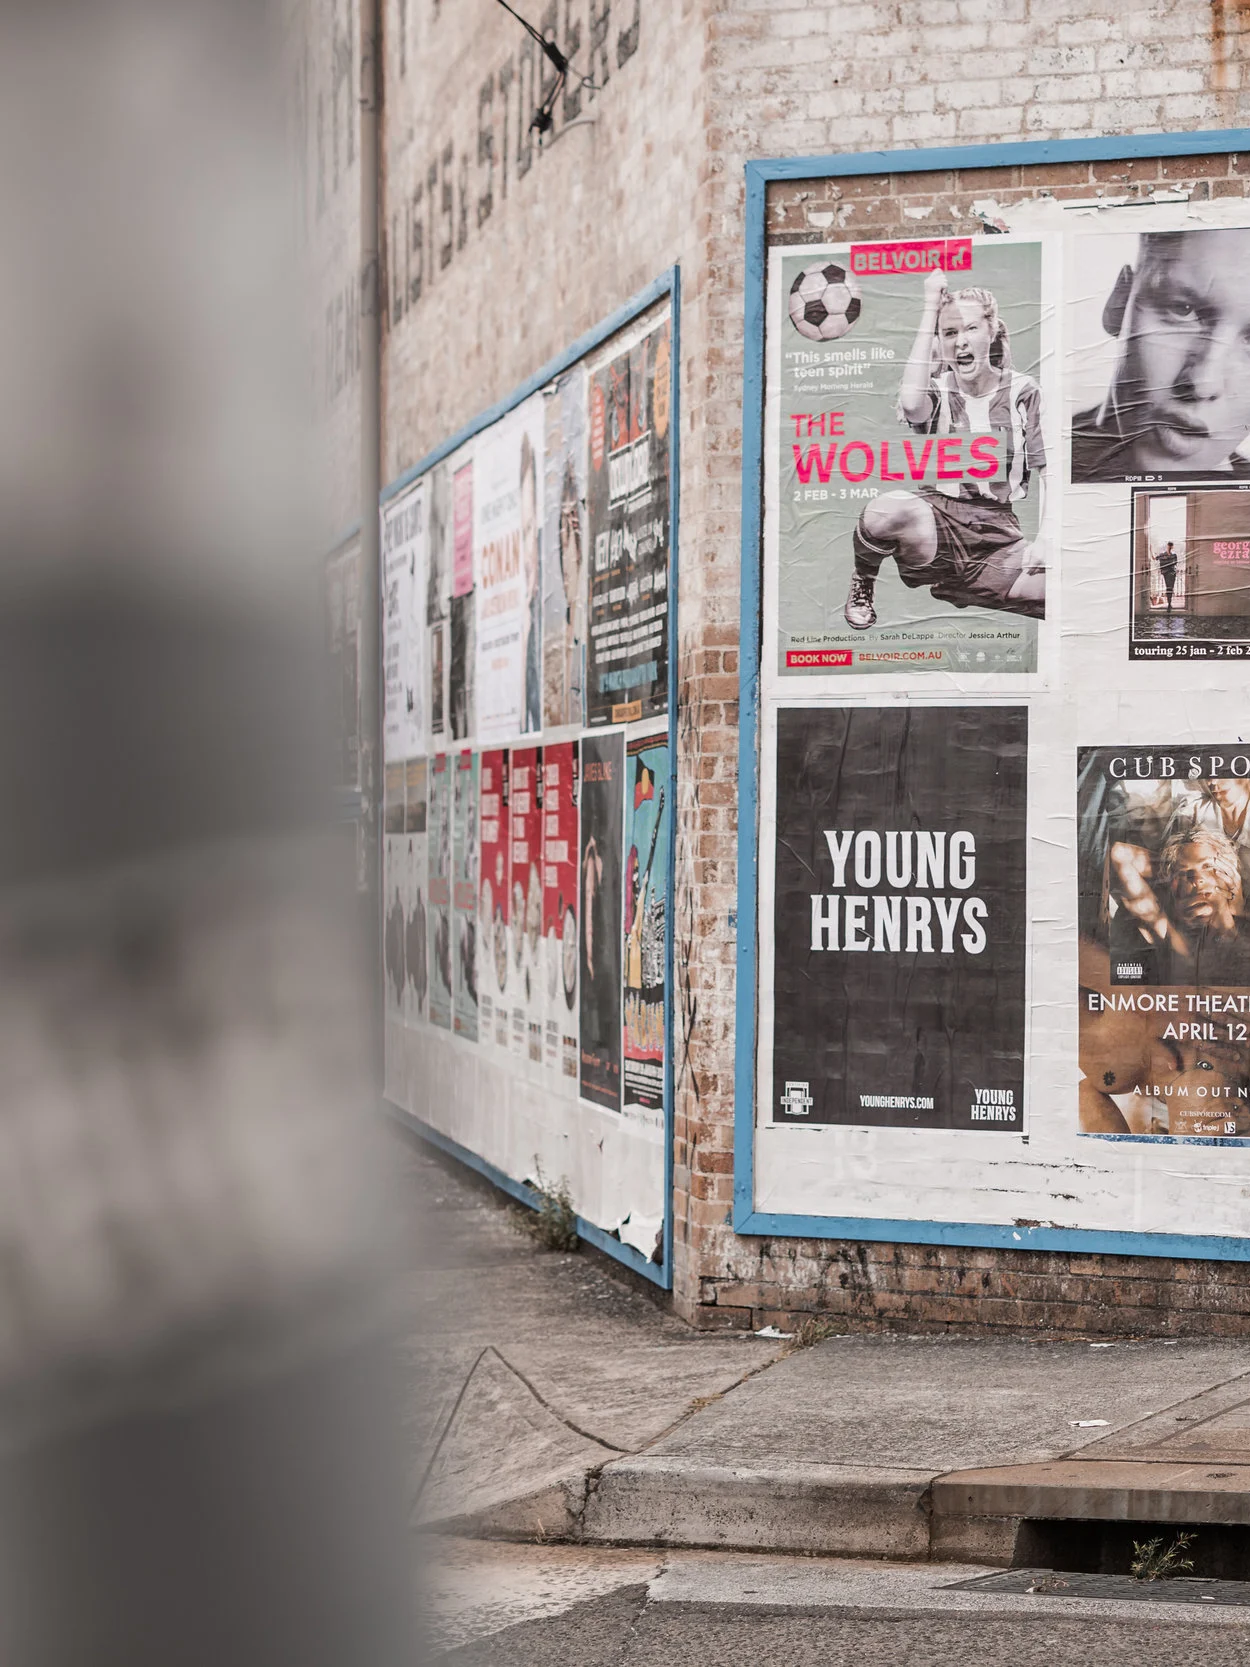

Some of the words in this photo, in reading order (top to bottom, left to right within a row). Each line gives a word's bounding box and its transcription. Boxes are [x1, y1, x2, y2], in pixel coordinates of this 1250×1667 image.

[854, 250, 941, 271] BELVOIR
[824, 348, 866, 361] smells
[871, 348, 895, 360] like
[794, 367, 824, 378] teen
[790, 412, 845, 437] THE
[792, 436, 999, 485] WOLVES
[793, 490, 801, 502] 2
[804, 489, 828, 501] FEB
[840, 489, 846, 499] 3
[850, 488, 879, 499] MAR
[1220, 550, 1250, 559] ezra
[823, 634, 865, 642] Productions
[902, 633, 934, 641] DeLappe
[791, 655, 820, 664] BOOK
[822, 654, 846, 663] NOW
[859, 651, 942, 662] BELVOIR.COM.AU
[1134, 646, 1173, 657] touring
[1176, 646, 1187, 655] 25
[1190, 646, 1206, 656] jan
[1218, 646, 1223, 655] 2
[1226, 646, 1242, 655] feb
[1109, 756, 1176, 778] CUB
[823, 830, 976, 890] YOUNG
[810, 894, 988, 954] HENRYS
[1088, 993, 1178, 1012] ENMORE
[1162, 1022, 1218, 1040] APRIL
[1227, 1024, 1247, 1041] 12
[975, 1088, 1014, 1105] YOUNG
[1133, 1085, 1189, 1097] ALBUM
[1197, 1086, 1231, 1098] OUT
[860, 1095, 934, 1109] YOUNGHENRYS.COM
[971, 1105, 1016, 1122] HENRYS
